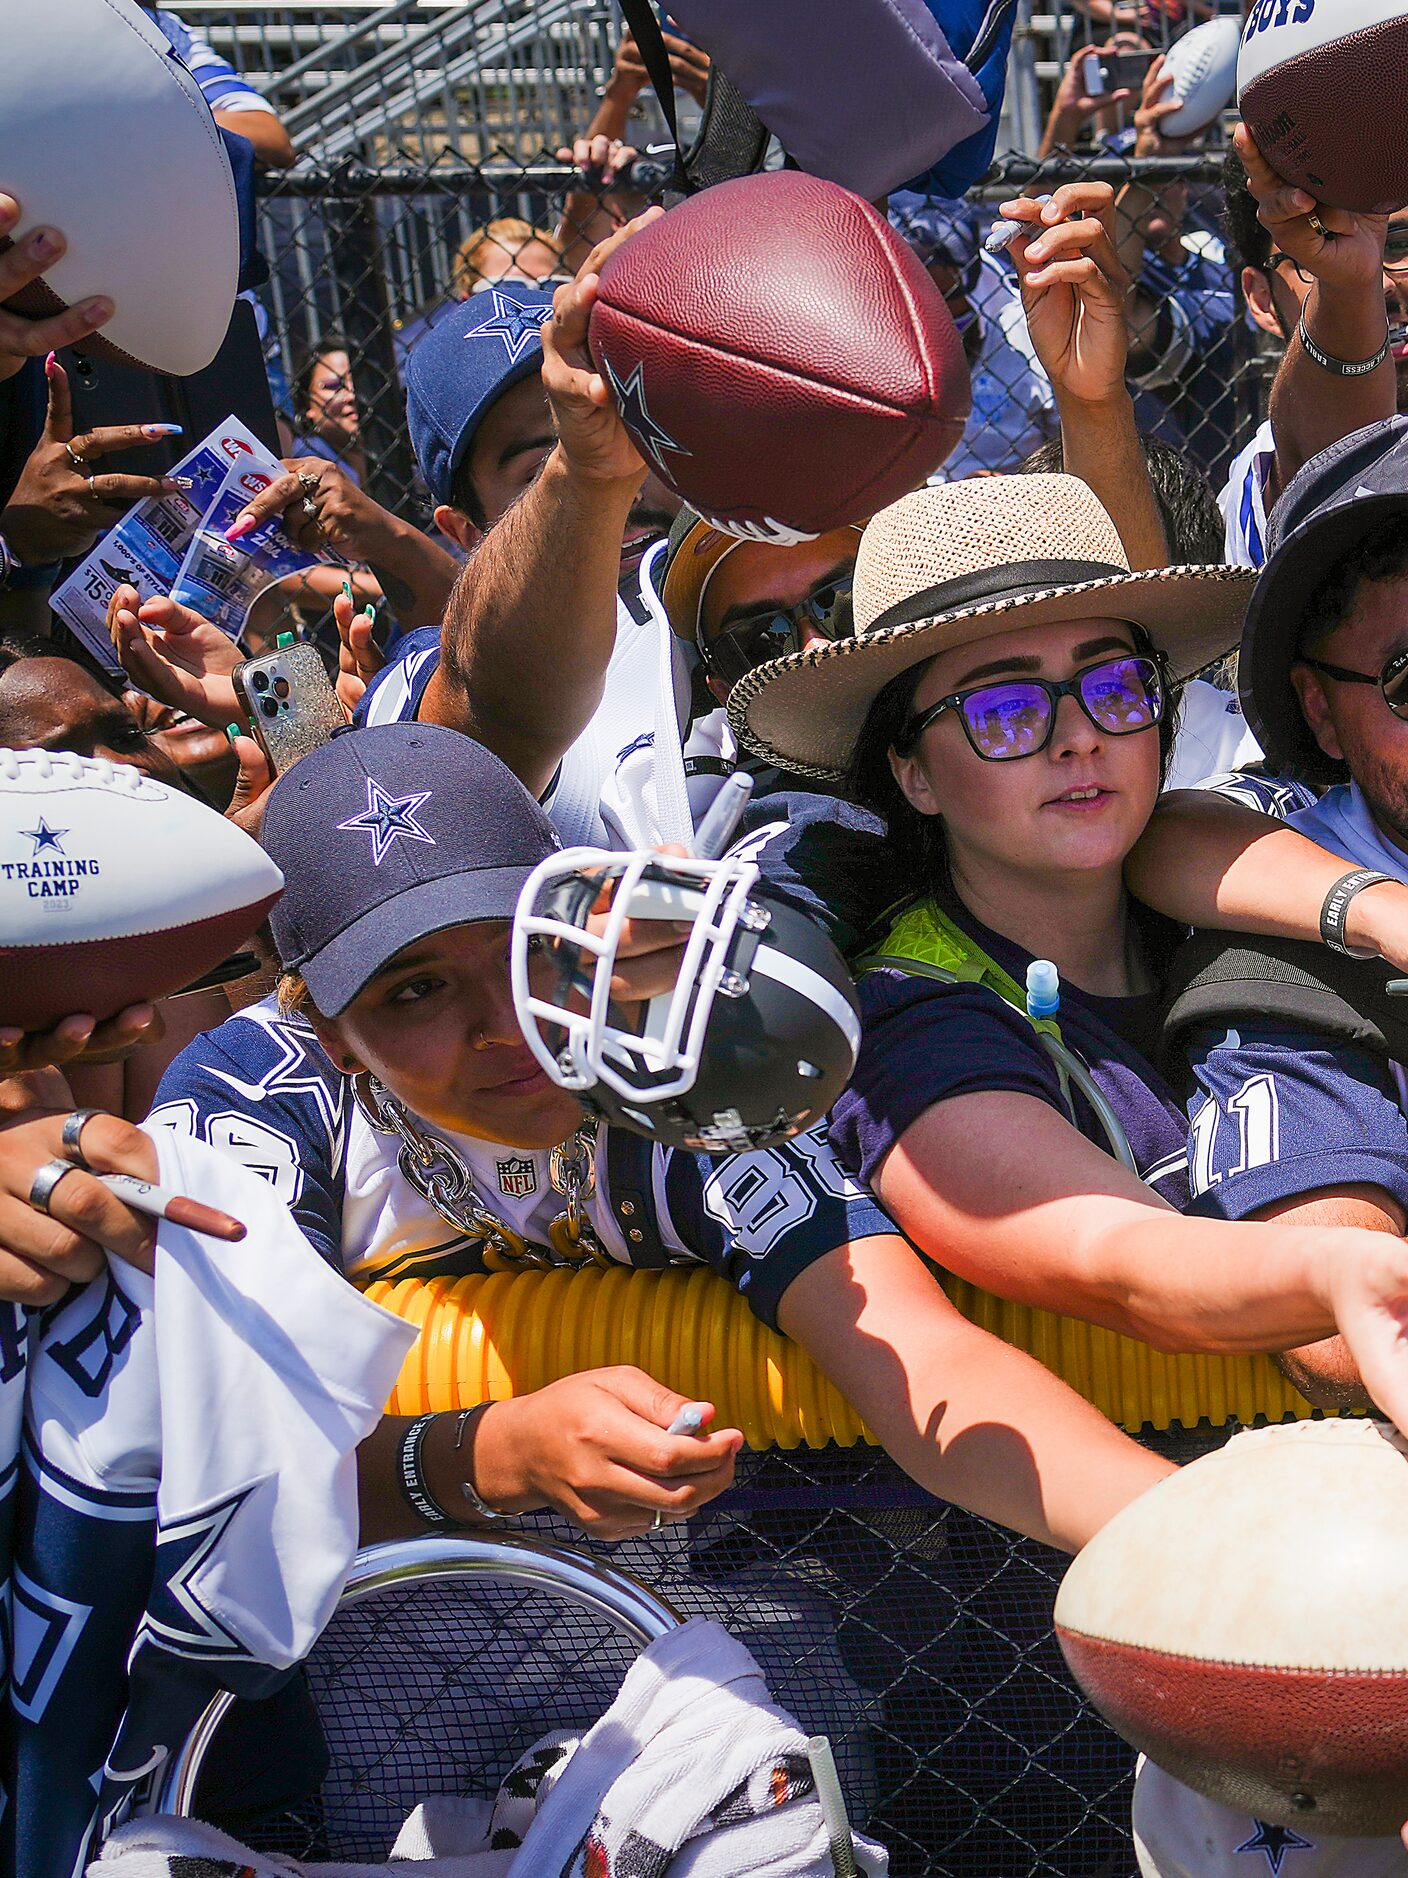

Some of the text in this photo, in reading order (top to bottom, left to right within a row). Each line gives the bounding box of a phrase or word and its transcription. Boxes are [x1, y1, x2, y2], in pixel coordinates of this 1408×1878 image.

[1345, 361, 1375, 374] ACCESS
[136, 563, 147, 574] OF
[1, 859, 100, 880] TRAINING
[28, 879, 80, 898] CAMP
[43, 899, 70, 910] 2023
[1326, 889, 1348, 927] EARLY
[1191, 1073, 1280, 1200] 11
[501, 1174, 534, 1195] NFL
[402, 1421, 445, 1522] EARLY ENTRANCE
